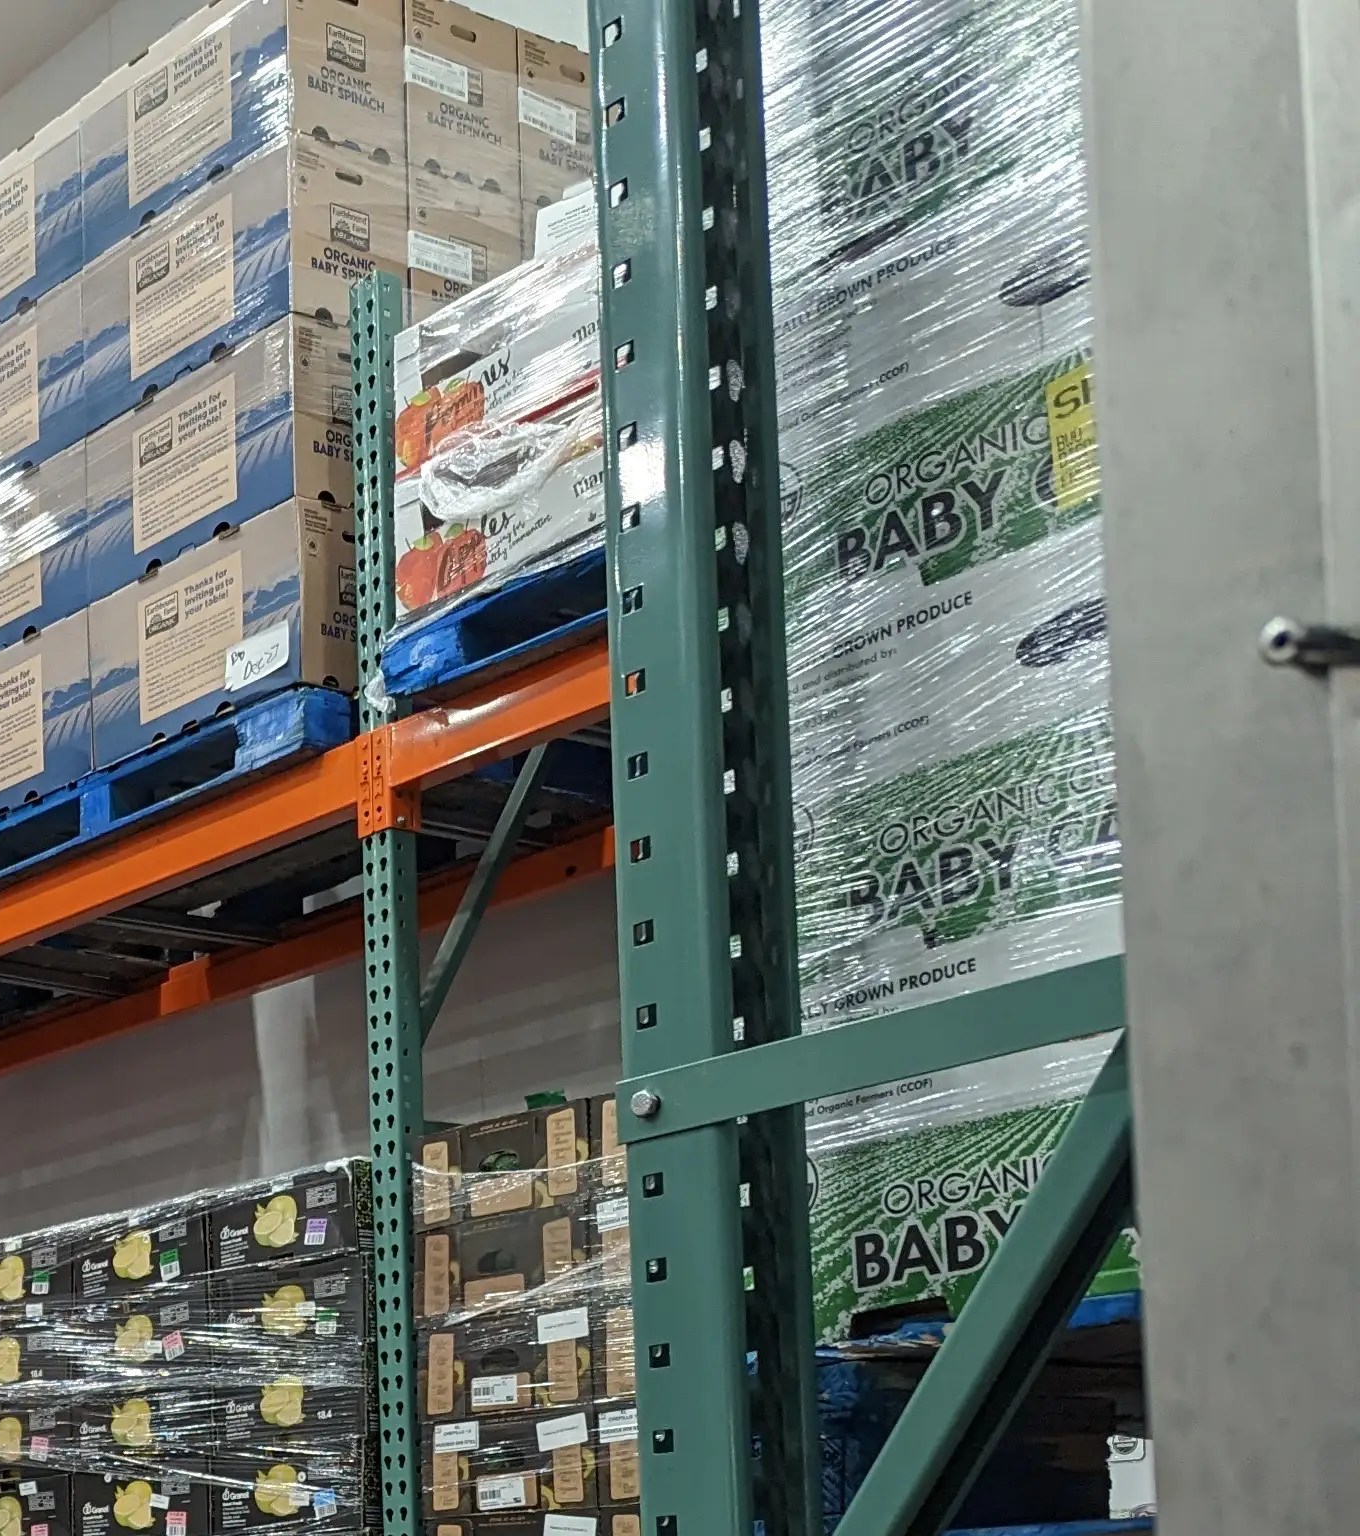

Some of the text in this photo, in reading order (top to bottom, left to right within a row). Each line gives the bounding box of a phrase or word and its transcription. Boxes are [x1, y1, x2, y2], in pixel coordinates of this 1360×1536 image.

[174, 46, 202, 70] Thanks
[174, 75, 192, 94] your
[308, 76, 385, 113] BABY SPINACH
[320, 65, 372, 95] ORGANIC
[427, 112, 502, 147] BABY SPINACH
[440, 102, 489, 129] ORGANIC
[311, 257, 338, 277] BABY
[323, 247, 376, 273] ORGANIC
[178, 391, 221, 422] Thanks for
[178, 410, 208, 434] inviting
[179, 414, 222, 446] your table!
[837, 467, 1006, 583] BABY
[184, 569, 228, 597] Thanks for
[184, 577, 234, 608] inviting us to
[185, 592, 229, 619] your table!
[321, 623, 346, 641] BABY
[833, 591, 972, 659] GROWN PRODUCE
[878, 774, 1058, 857] ORGANIC
[846, 838, 1025, 930] BABY
[834, 957, 977, 1011] GROWN PRODUCE
[817, 1096, 853, 1114] Organic
[896, 1078, 933, 1097] (CCOF)
